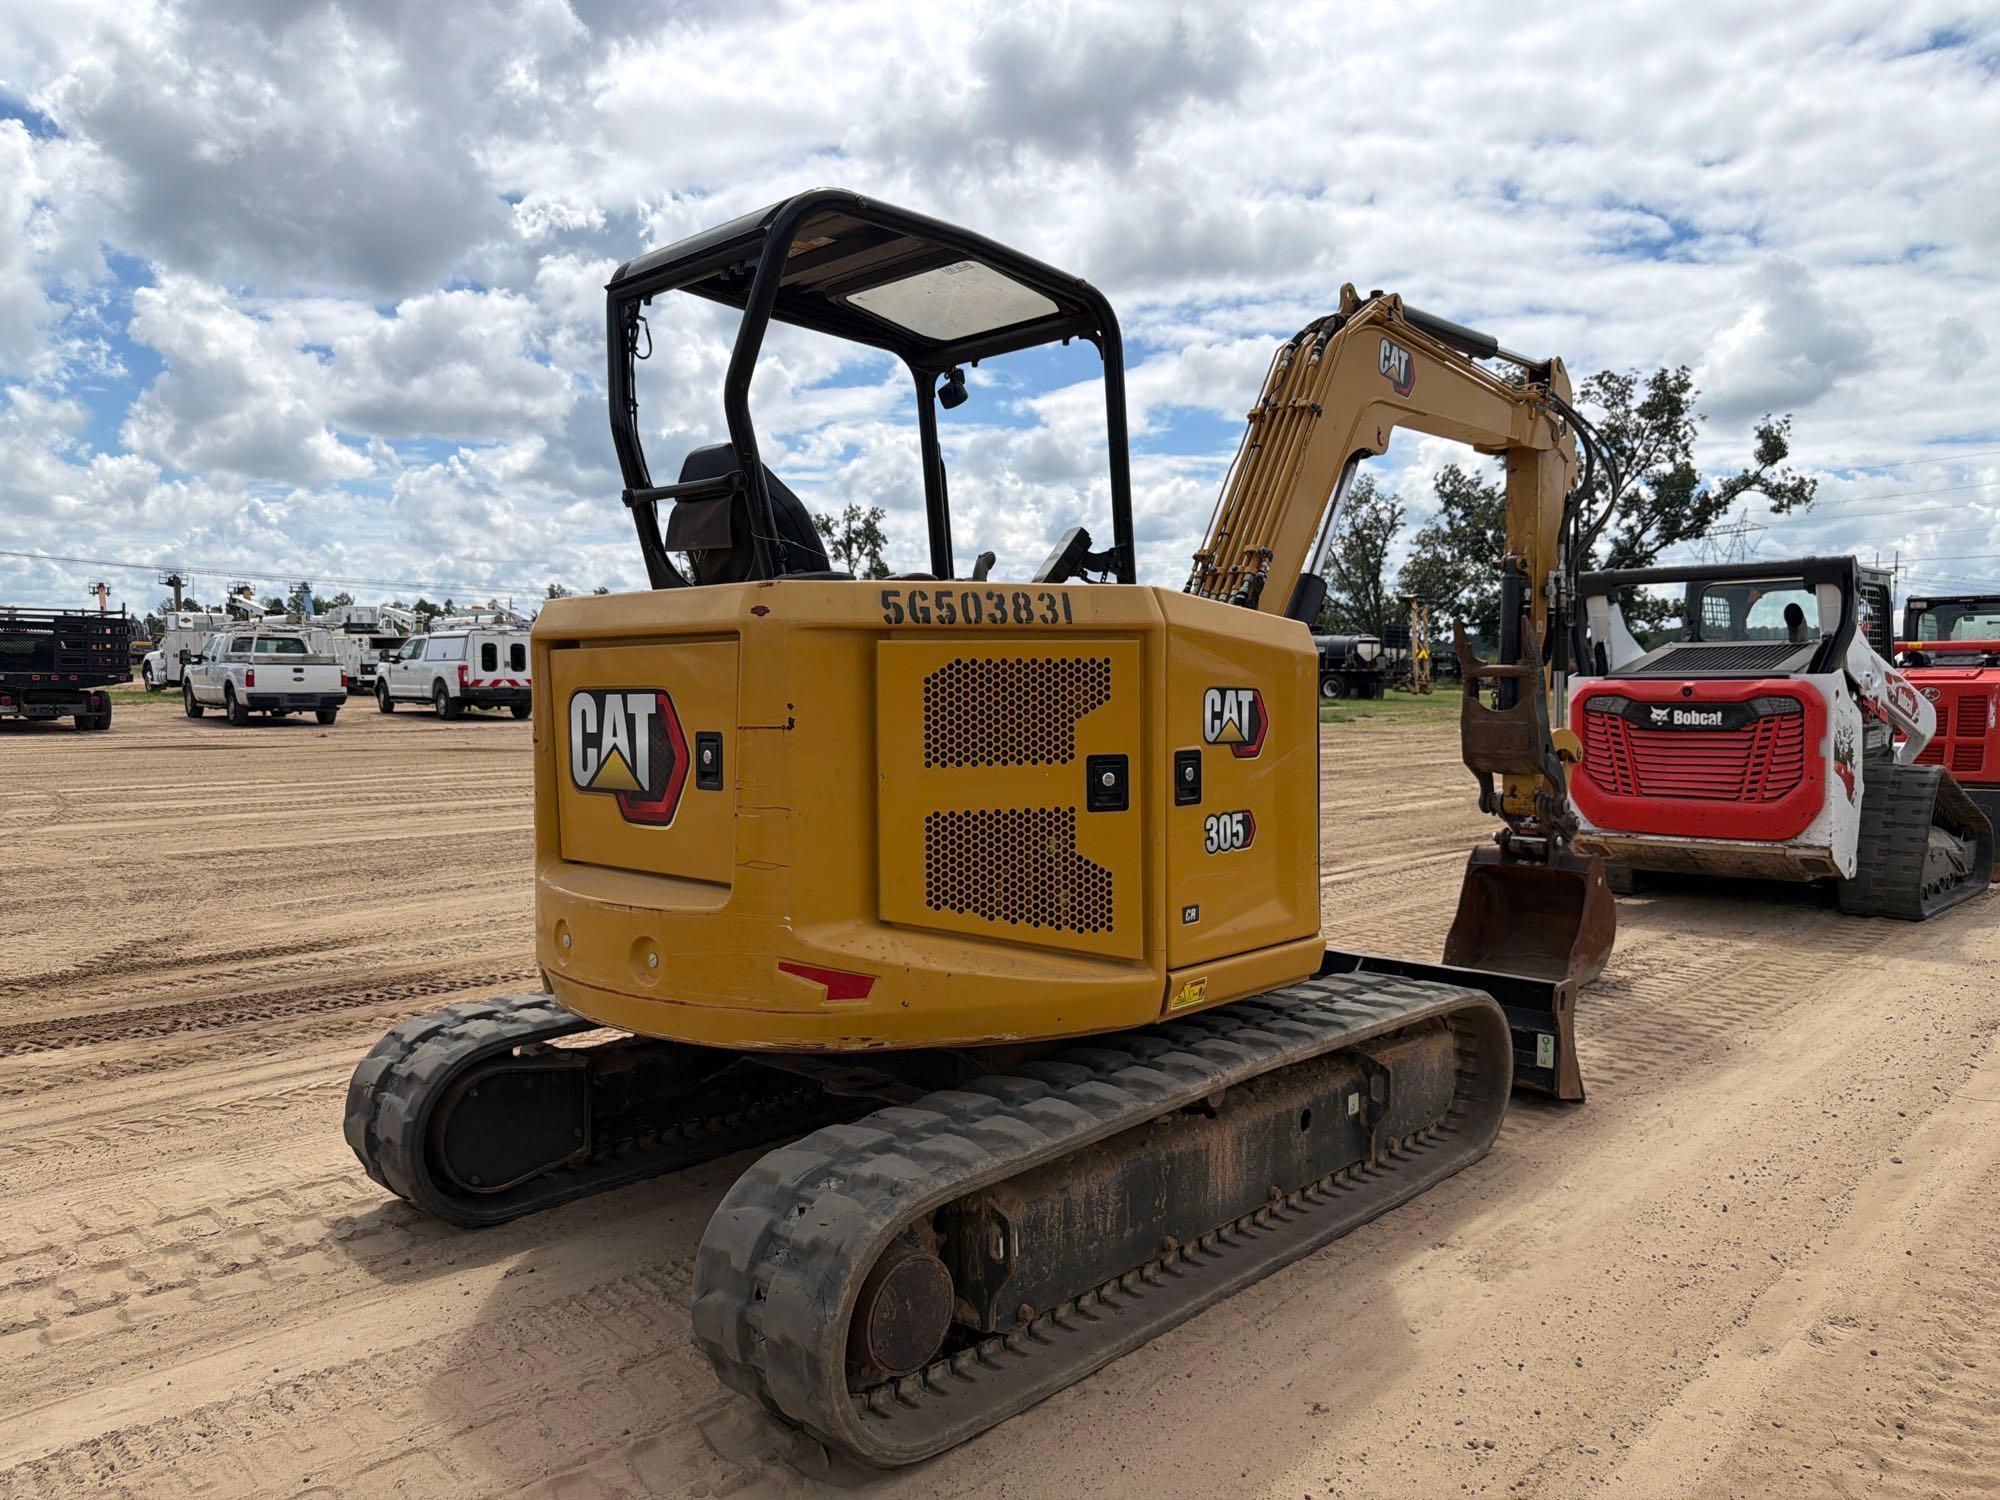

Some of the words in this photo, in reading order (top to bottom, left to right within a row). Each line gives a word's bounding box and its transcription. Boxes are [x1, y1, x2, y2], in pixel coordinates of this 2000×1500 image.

[1379, 339, 1409, 385] CAT
[1204, 688, 1254, 742] CAT
[1673, 709, 1723, 726] Bobcat
[570, 692, 656, 792] CAT
[1205, 812, 1245, 852] 305
[1185, 908, 1197, 922] CR
